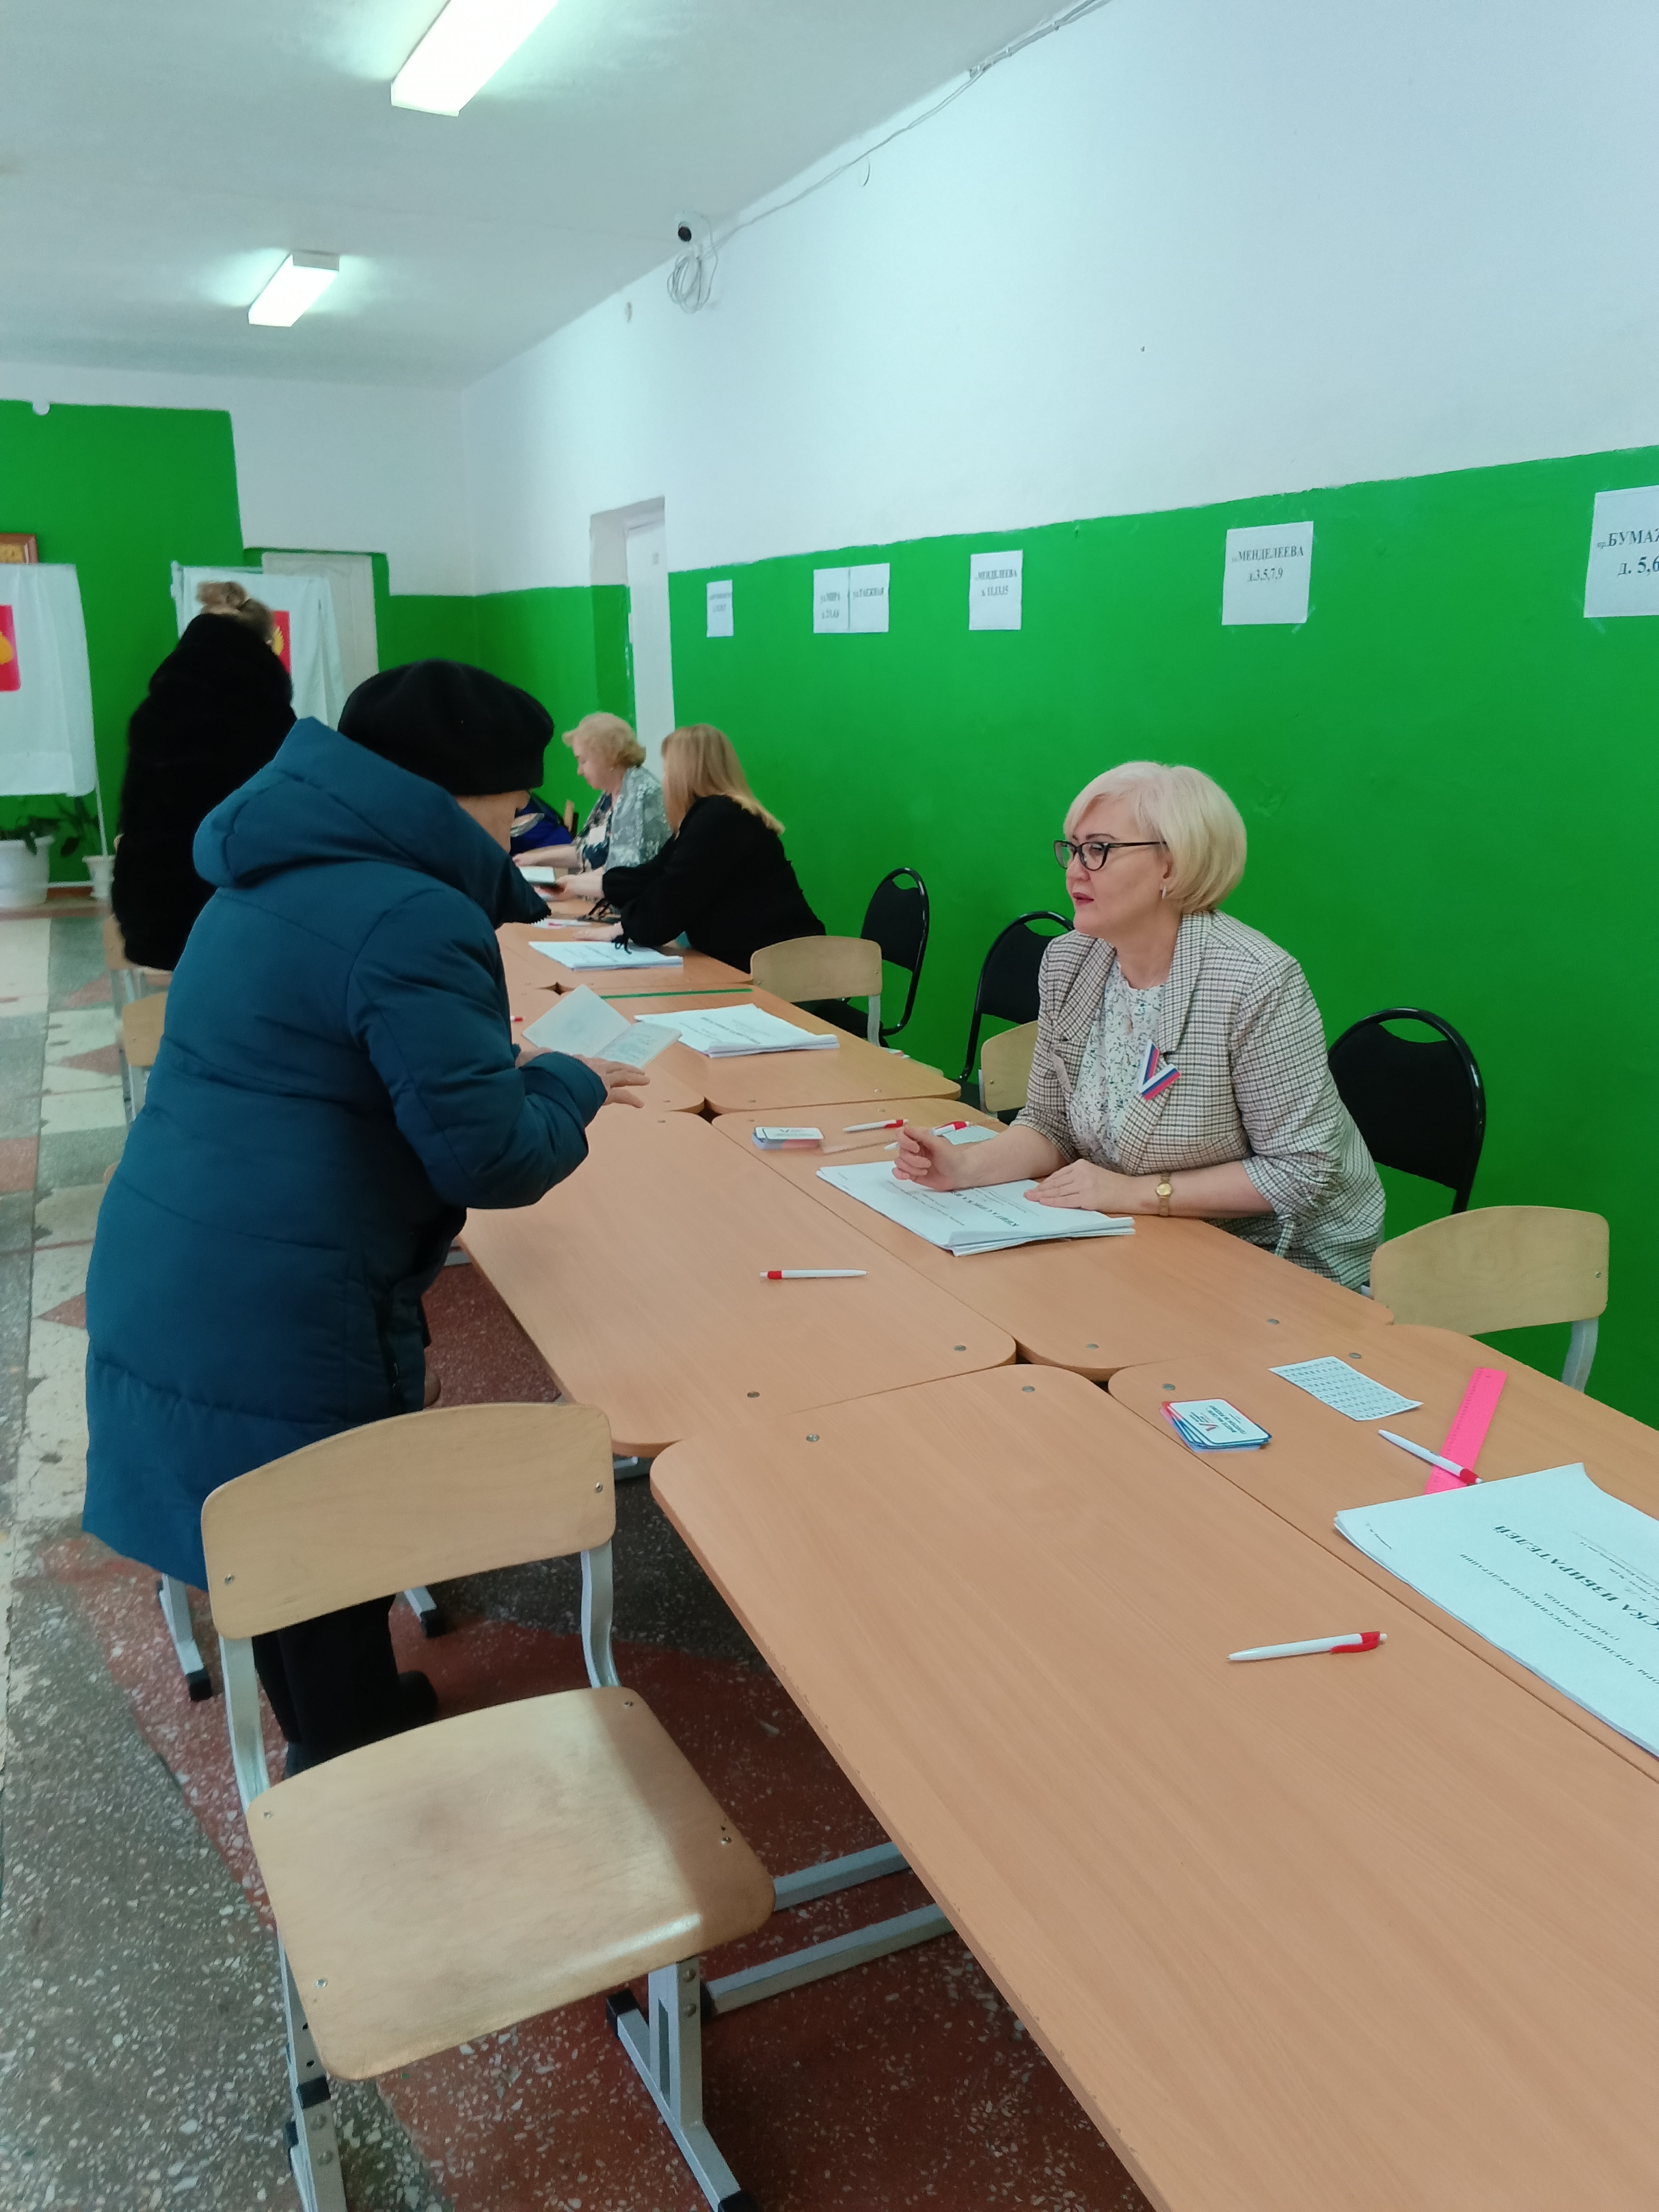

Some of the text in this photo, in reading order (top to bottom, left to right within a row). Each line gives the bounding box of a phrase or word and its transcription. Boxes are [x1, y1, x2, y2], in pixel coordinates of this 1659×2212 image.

[1460, 1553, 1510, 1586] ФЕДЕРАЦИИ
[1491, 1526, 1620, 1601] ИЗБИРАТЕЛЕЙ
[1510, 1587, 1572, 1628] РОССИЙСКОЙ
[1622, 1603, 1659, 1630] СКА
[1573, 1629, 1635, 1666] ПРЕЗИДЕНТА
